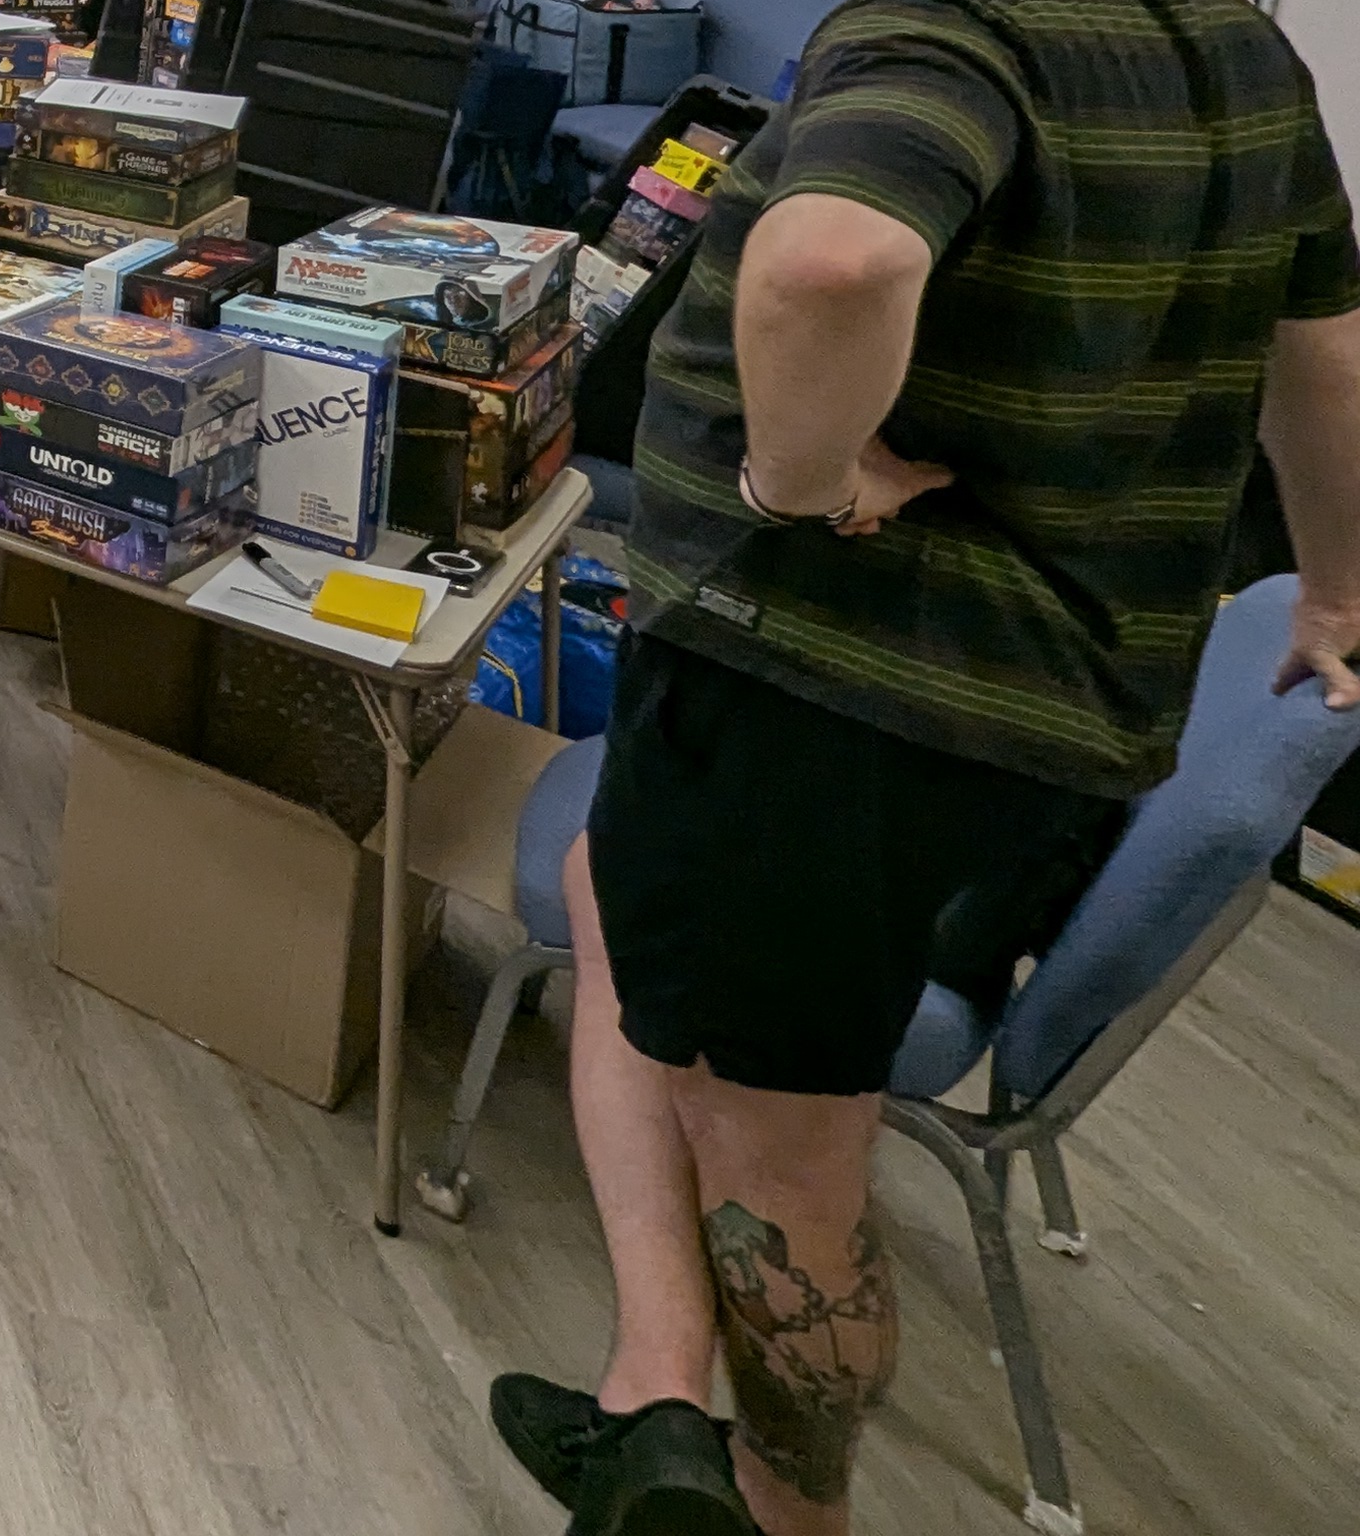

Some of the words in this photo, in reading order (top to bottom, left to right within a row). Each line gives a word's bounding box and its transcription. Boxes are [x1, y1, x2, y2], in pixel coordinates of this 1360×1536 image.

[116, 158, 169, 175] THRONES
[125, 151, 156, 164] GAME
[239, 331, 356, 362] SEQUENCE
[446, 331, 486, 351] LORD
[442, 348, 492, 370] RINGS
[256, 387, 368, 446] UENCE
[97, 430, 161, 459] JACK
[30, 445, 114, 486] UNTOLD
[61, 504, 106, 540] RUSH
